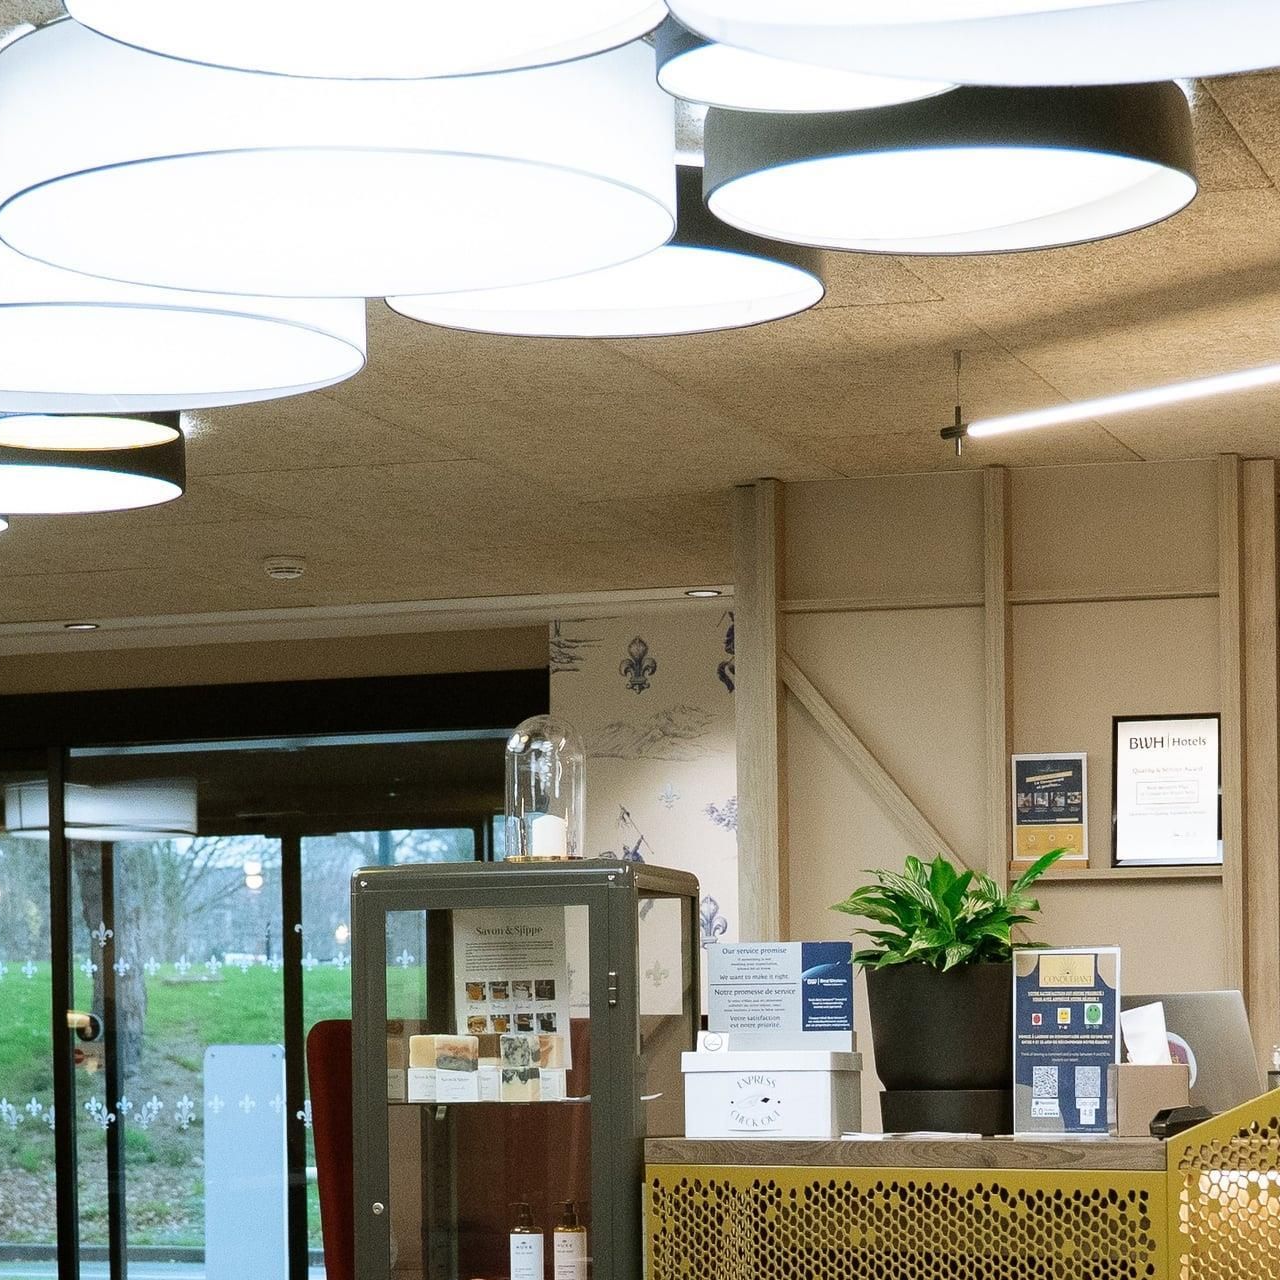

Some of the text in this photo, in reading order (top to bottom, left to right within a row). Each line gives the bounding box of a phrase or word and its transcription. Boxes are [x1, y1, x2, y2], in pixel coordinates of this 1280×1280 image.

[1129, 736, 1206, 749] BWH Hotels
[476, 927, 503, 935] Savon
[505, 927, 513, 935] &
[722, 947, 735, 955] Our
[760, 947, 787, 956] promise
[714, 988, 733, 996] Notre
[734, 989, 764, 997] promesse
[736, 1074, 776, 1089] EXPRESS
